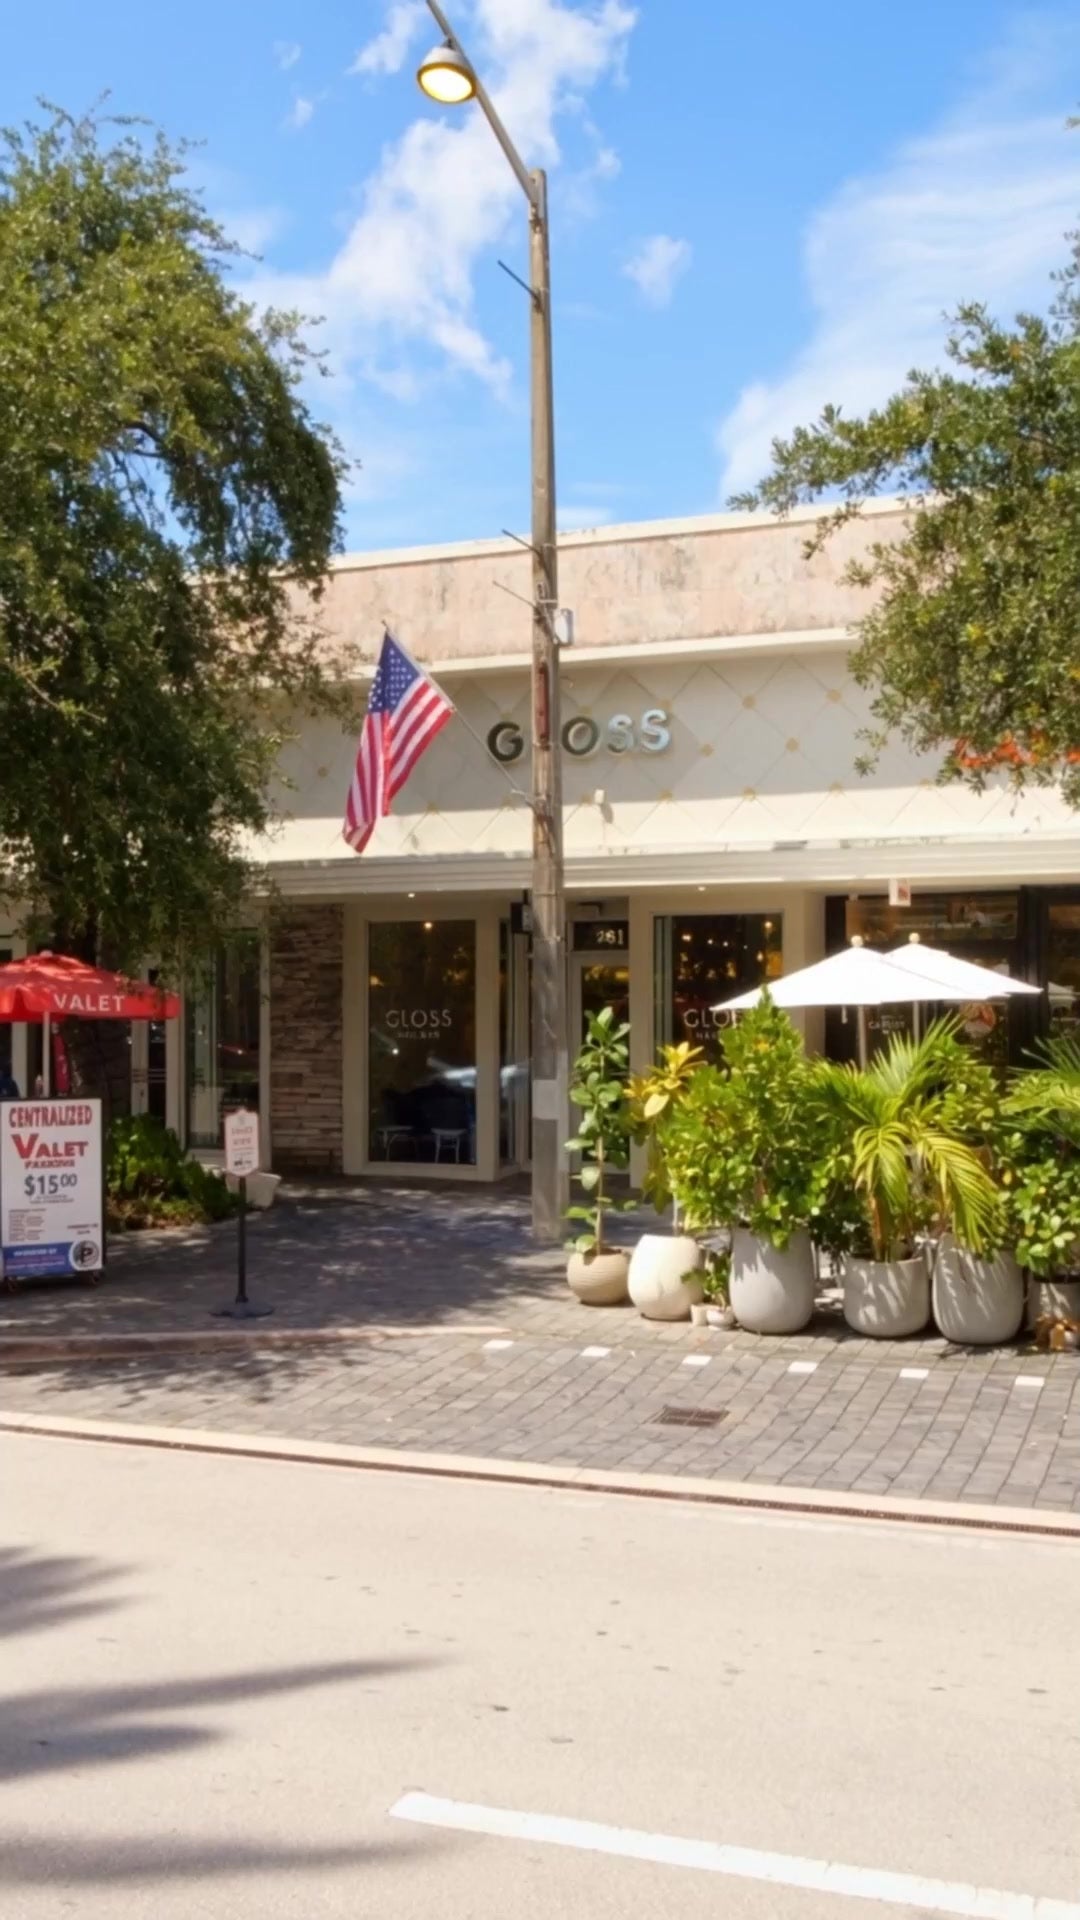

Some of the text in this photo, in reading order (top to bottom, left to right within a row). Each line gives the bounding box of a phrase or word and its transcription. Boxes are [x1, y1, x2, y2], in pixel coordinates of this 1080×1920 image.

[487, 708, 671, 762] GOSS
[53, 993, 125, 1013] VALET
[386, 1008, 453, 1028] GLOSS
[8, 1104, 93, 1128] CENTRALIZED
[10, 1133, 89, 1159] VALET
